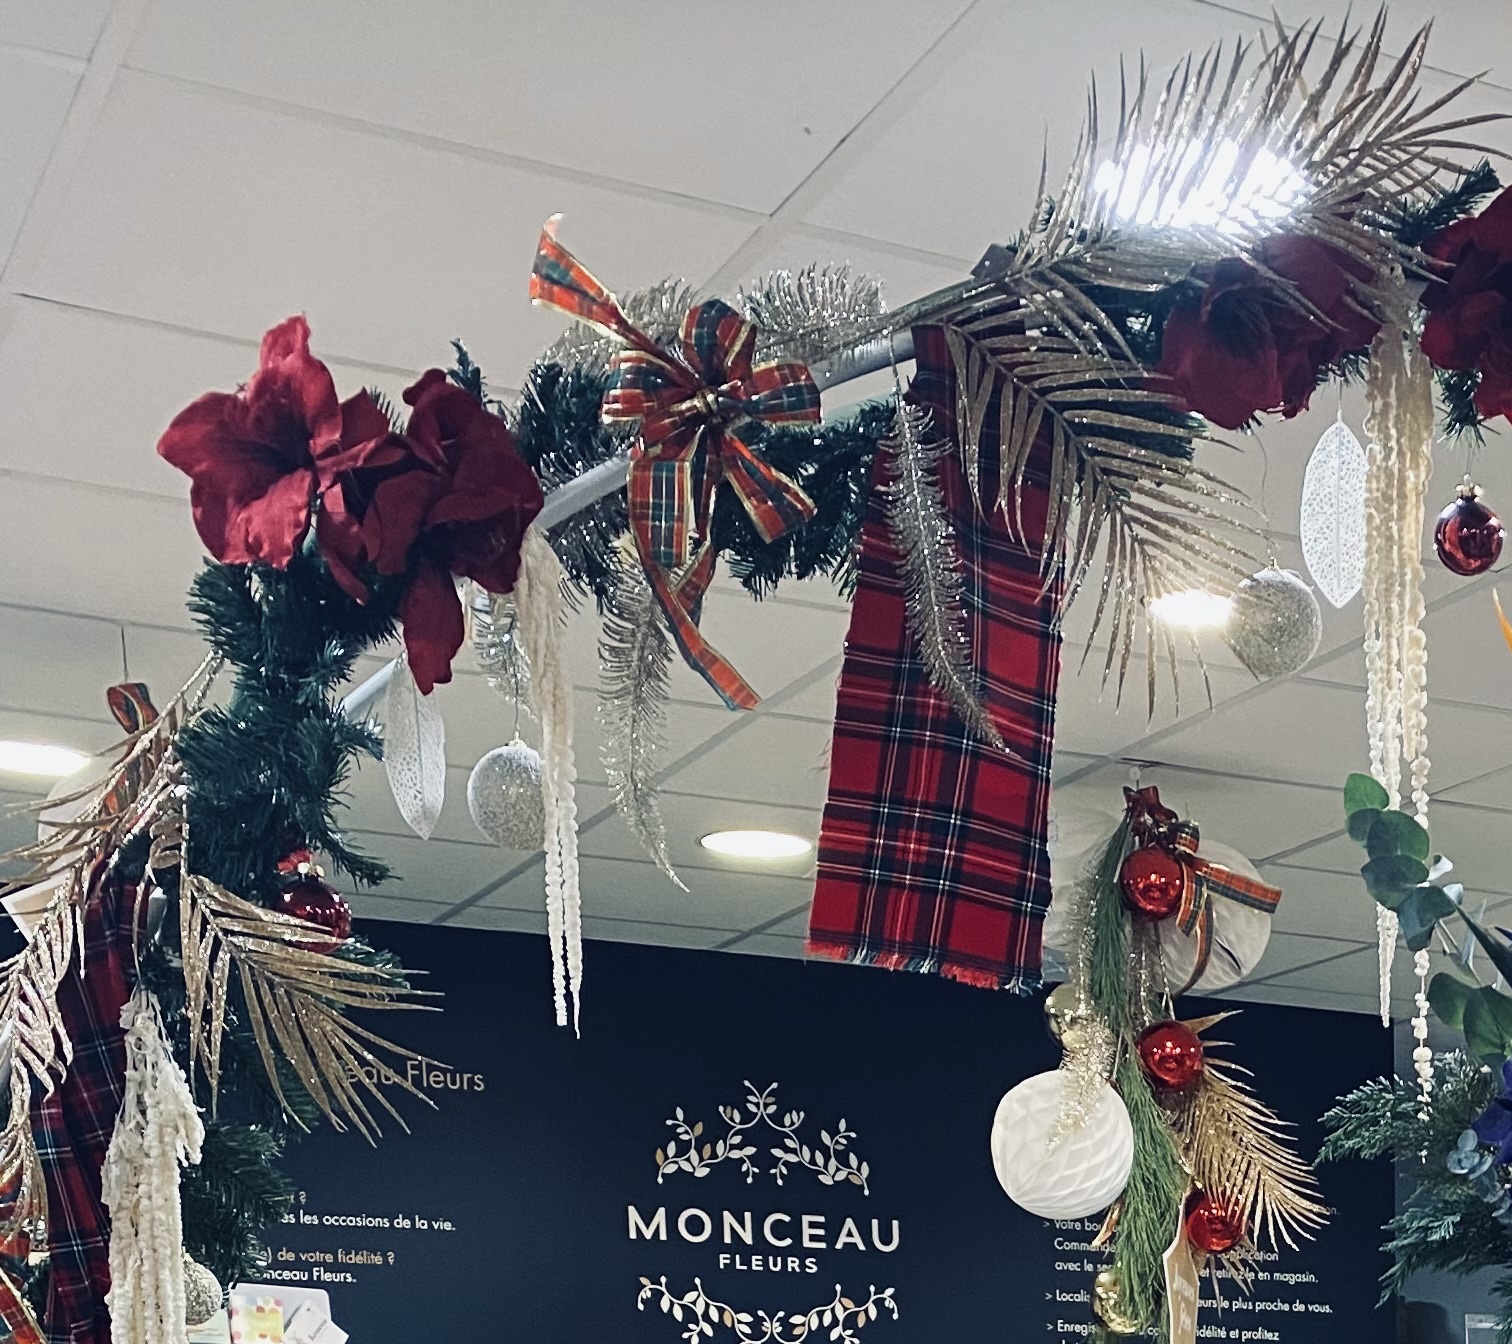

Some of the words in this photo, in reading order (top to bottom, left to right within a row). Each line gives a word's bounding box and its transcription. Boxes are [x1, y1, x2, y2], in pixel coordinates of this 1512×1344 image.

[406, 1060, 486, 1092] Fleurs
[299, 1209, 319, 1226] les
[322, 1213, 390, 1229] occasions
[393, 1213, 411, 1230] de
[415, 1214, 428, 1231] la
[431, 1216, 457, 1232] vie.
[627, 1204, 901, 1253] MONCEAU
[276, 1246, 296, 1262] de
[299, 1250, 334, 1264] votre
[337, 1248, 384, 1266] fidélité
[387, 1250, 396, 1266] ?
[718, 1253, 819, 1274] FLEURS
[1054, 1262, 1081, 1273] avec
[1083, 1259, 1094, 1273] le
[264, 1269, 309, 1281] nceau
[312, 1266, 358, 1284] Fleurs.
[1258, 1271, 1270, 1281] en
[1273, 1271, 1319, 1285] magasin.
[1220, 1298, 1230, 1309] le
[1232, 1296, 1254, 1313] plus
[1255, 1299, 1290, 1316] proche
[1292, 1299, 1306, 1312] de
[1307, 1303, 1334, 1314] vous.
[1196, 1325, 1227, 1339] idélité
[1229, 1328, 1239, 1339] et
[1241, 1327, 1280, 1341] profitez
